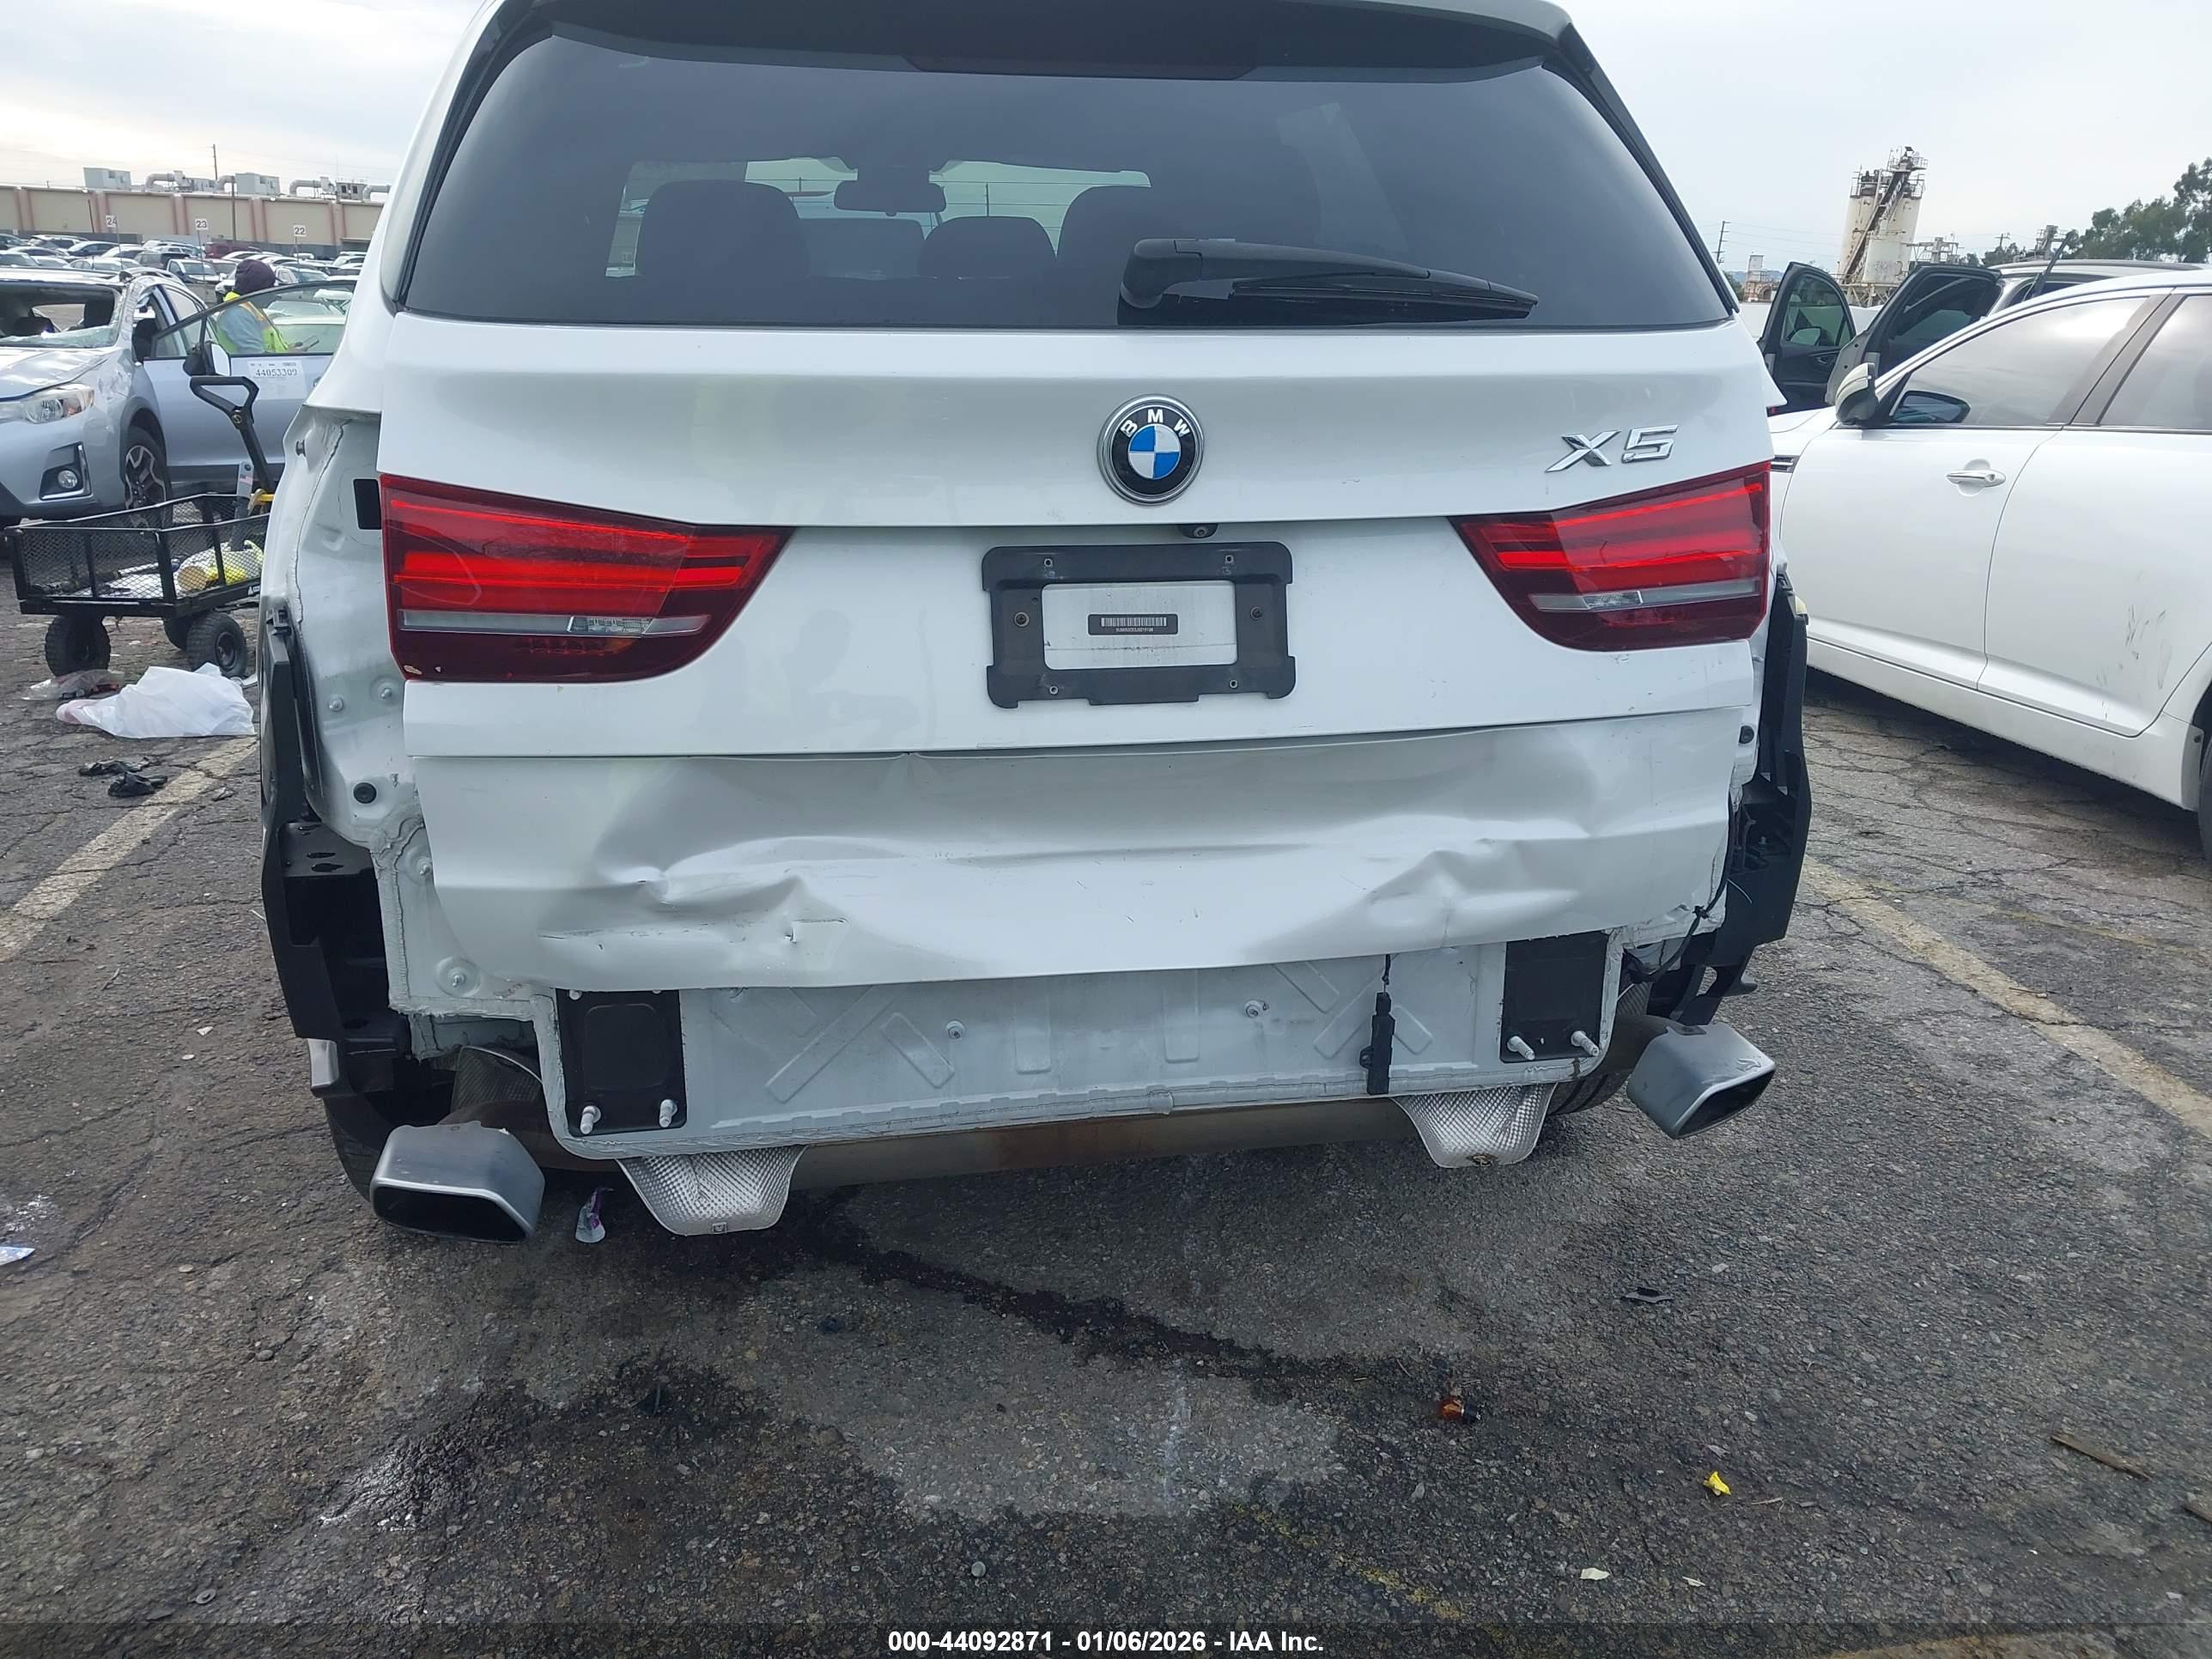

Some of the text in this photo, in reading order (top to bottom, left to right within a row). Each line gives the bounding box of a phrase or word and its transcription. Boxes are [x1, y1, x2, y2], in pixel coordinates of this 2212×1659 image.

[196, 220, 207, 228] 23
[295, 227, 305, 235] 22
[1120, 409, 1191, 438] BMW
[1544, 424, 1679, 473] X5
